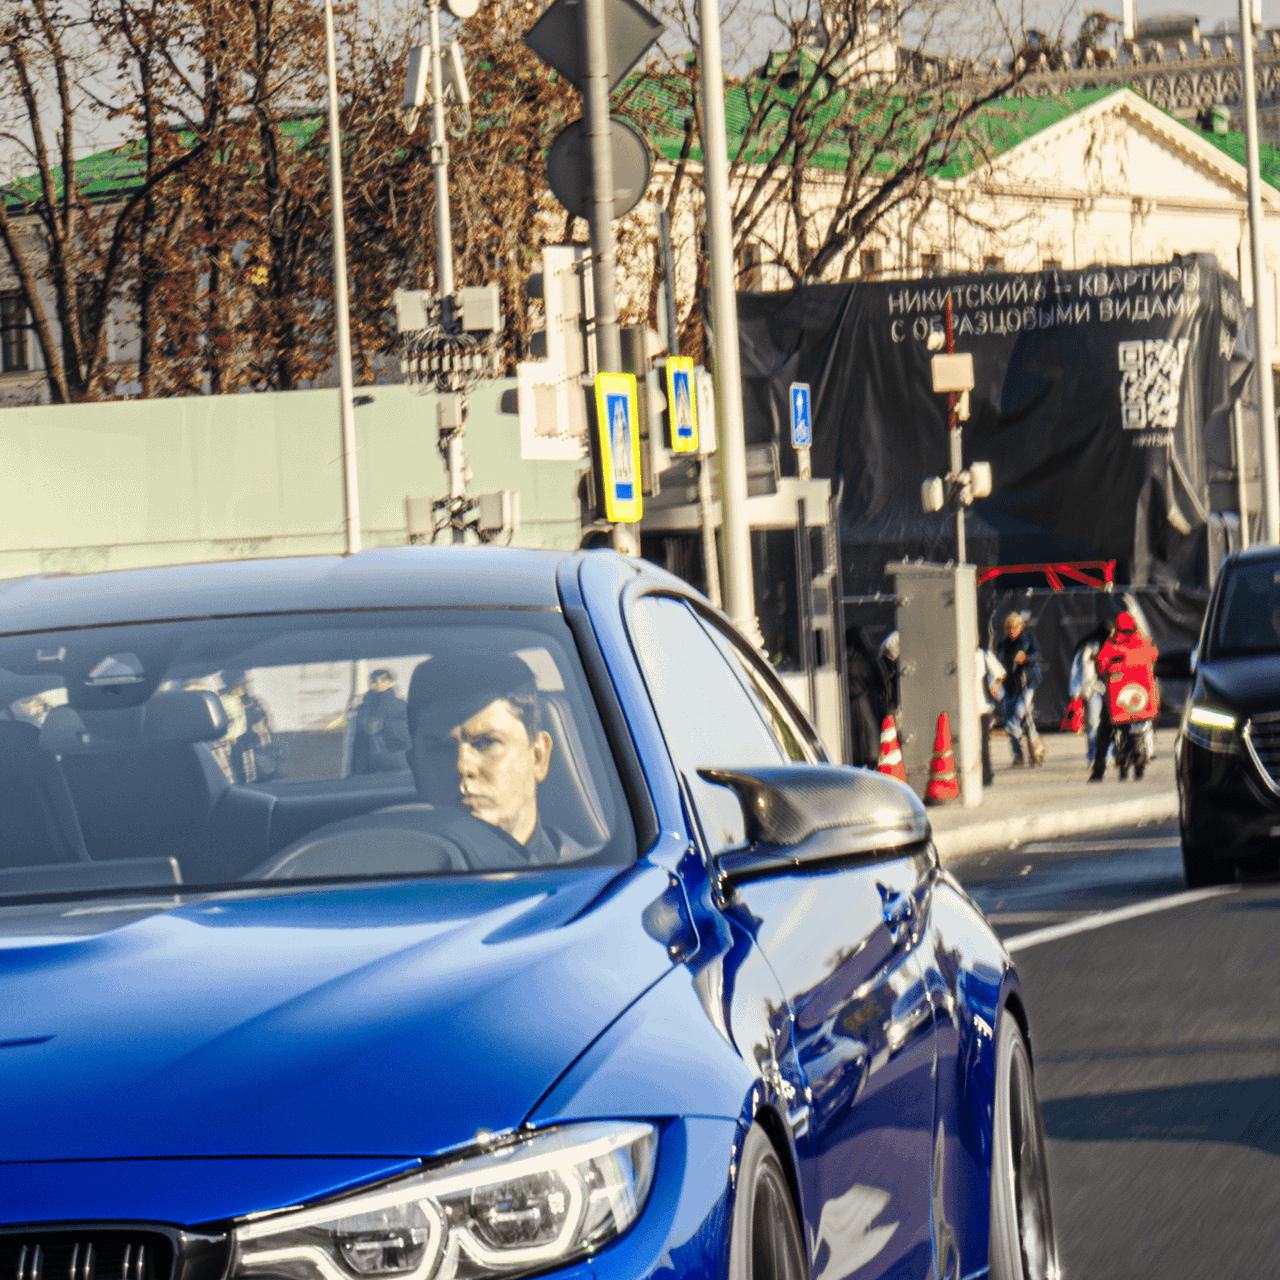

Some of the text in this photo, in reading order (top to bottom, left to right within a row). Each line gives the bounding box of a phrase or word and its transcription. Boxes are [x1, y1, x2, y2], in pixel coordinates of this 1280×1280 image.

[1079, 265, 1200, 297] КВАРТИРЫ
[891, 320, 905, 343] С
[913, 301, 1090, 341] ОБРАЗЦОВЫМИ
[1100, 293, 1200, 324] ВИДАМИ
